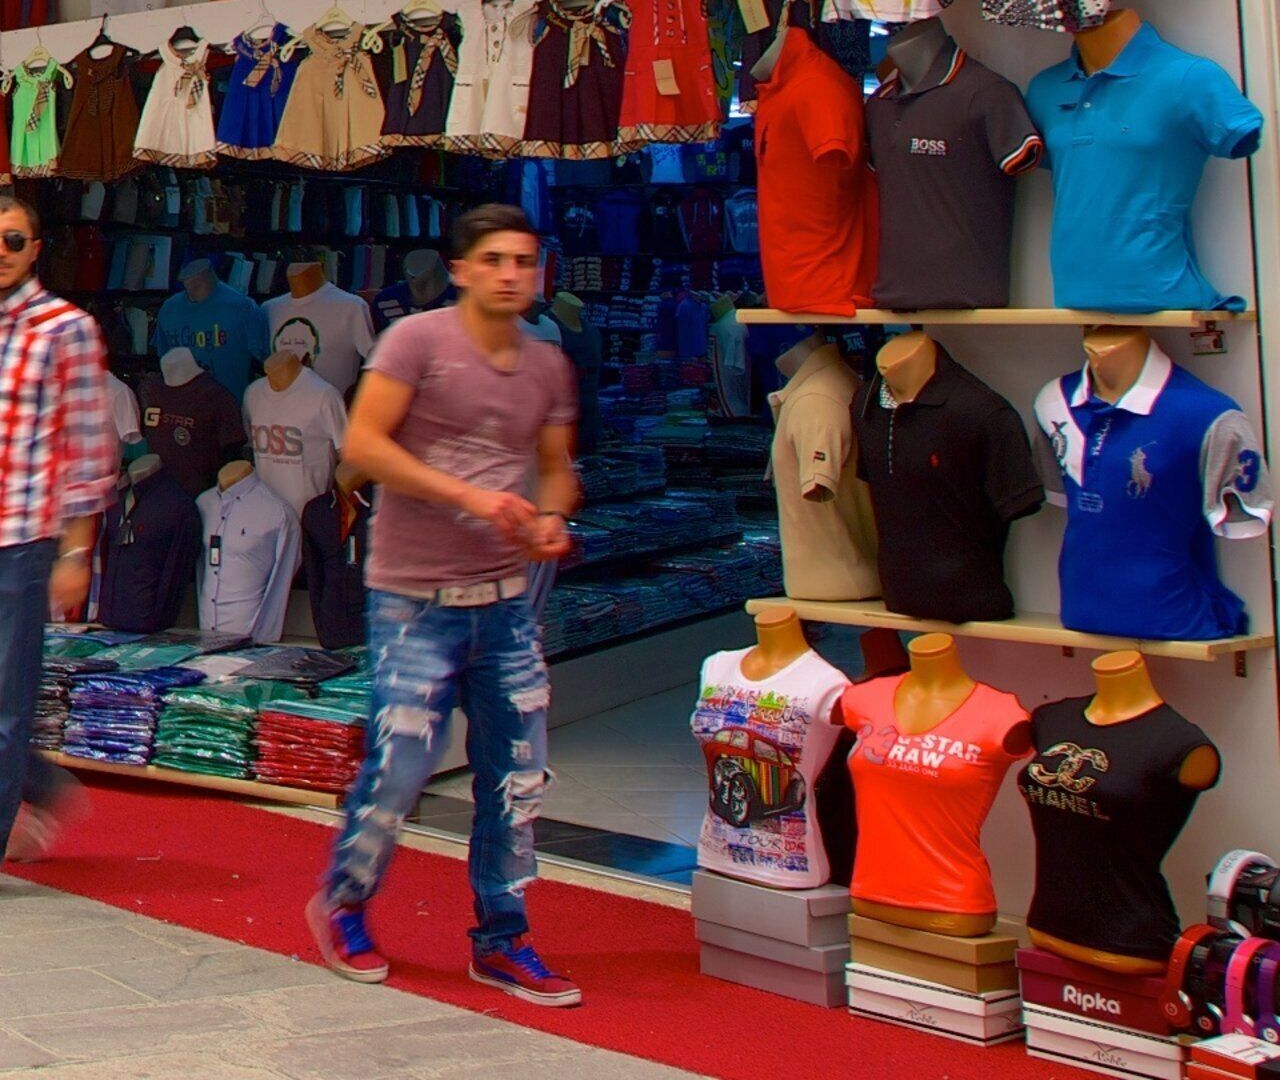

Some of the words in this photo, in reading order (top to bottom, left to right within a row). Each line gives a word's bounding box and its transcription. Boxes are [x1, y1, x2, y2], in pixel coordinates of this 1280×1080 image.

[911, 137, 947, 152] BOSS
[251, 424, 304, 457] OSS
[1233, 449, 1262, 493] 3
[887, 743, 946, 769] RAW
[1062, 983, 1122, 1016] Ripka
